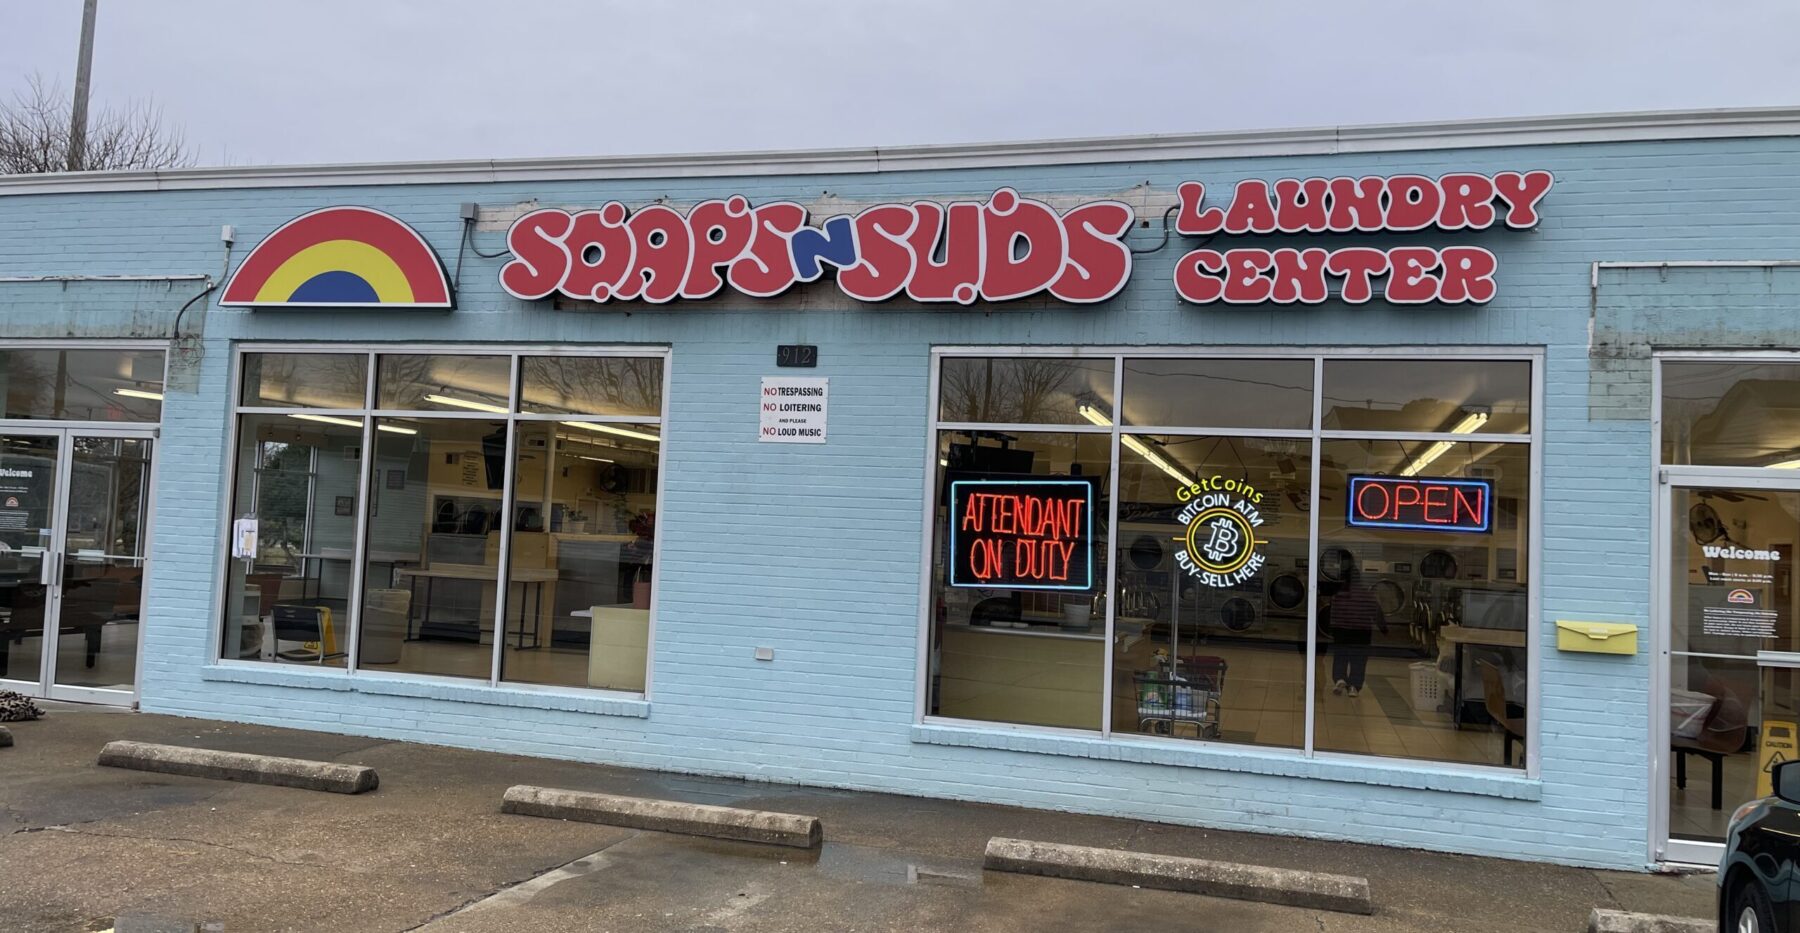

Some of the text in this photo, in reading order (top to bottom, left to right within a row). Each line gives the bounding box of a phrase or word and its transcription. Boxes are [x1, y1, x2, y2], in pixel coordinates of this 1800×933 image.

[1175, 170, 1554, 235] LAUNDRY
[498, 187, 1135, 305] SOAPS N SUDS
[1173, 245, 1498, 304] CENTER
[782, 346, 812, 365] 912
[763, 403, 822, 412] NO LOITERING
[764, 387, 823, 397] NO TRESPASSING
[762, 427, 822, 437] NO LOUD MUSIC
[1176, 475, 1264, 504] GetCoins
[1357, 483, 1482, 525] OPEN
[962, 493, 1085, 540] ATTENDANT
[1177, 493, 1230, 526] BITCOIN
[1233, 500, 1265, 528] ATM
[970, 538, 1075, 581] ON DUTY
[1175, 549, 1266, 588] BUY-SELL HERE
[1702, 545, 1781, 561] Welcome
